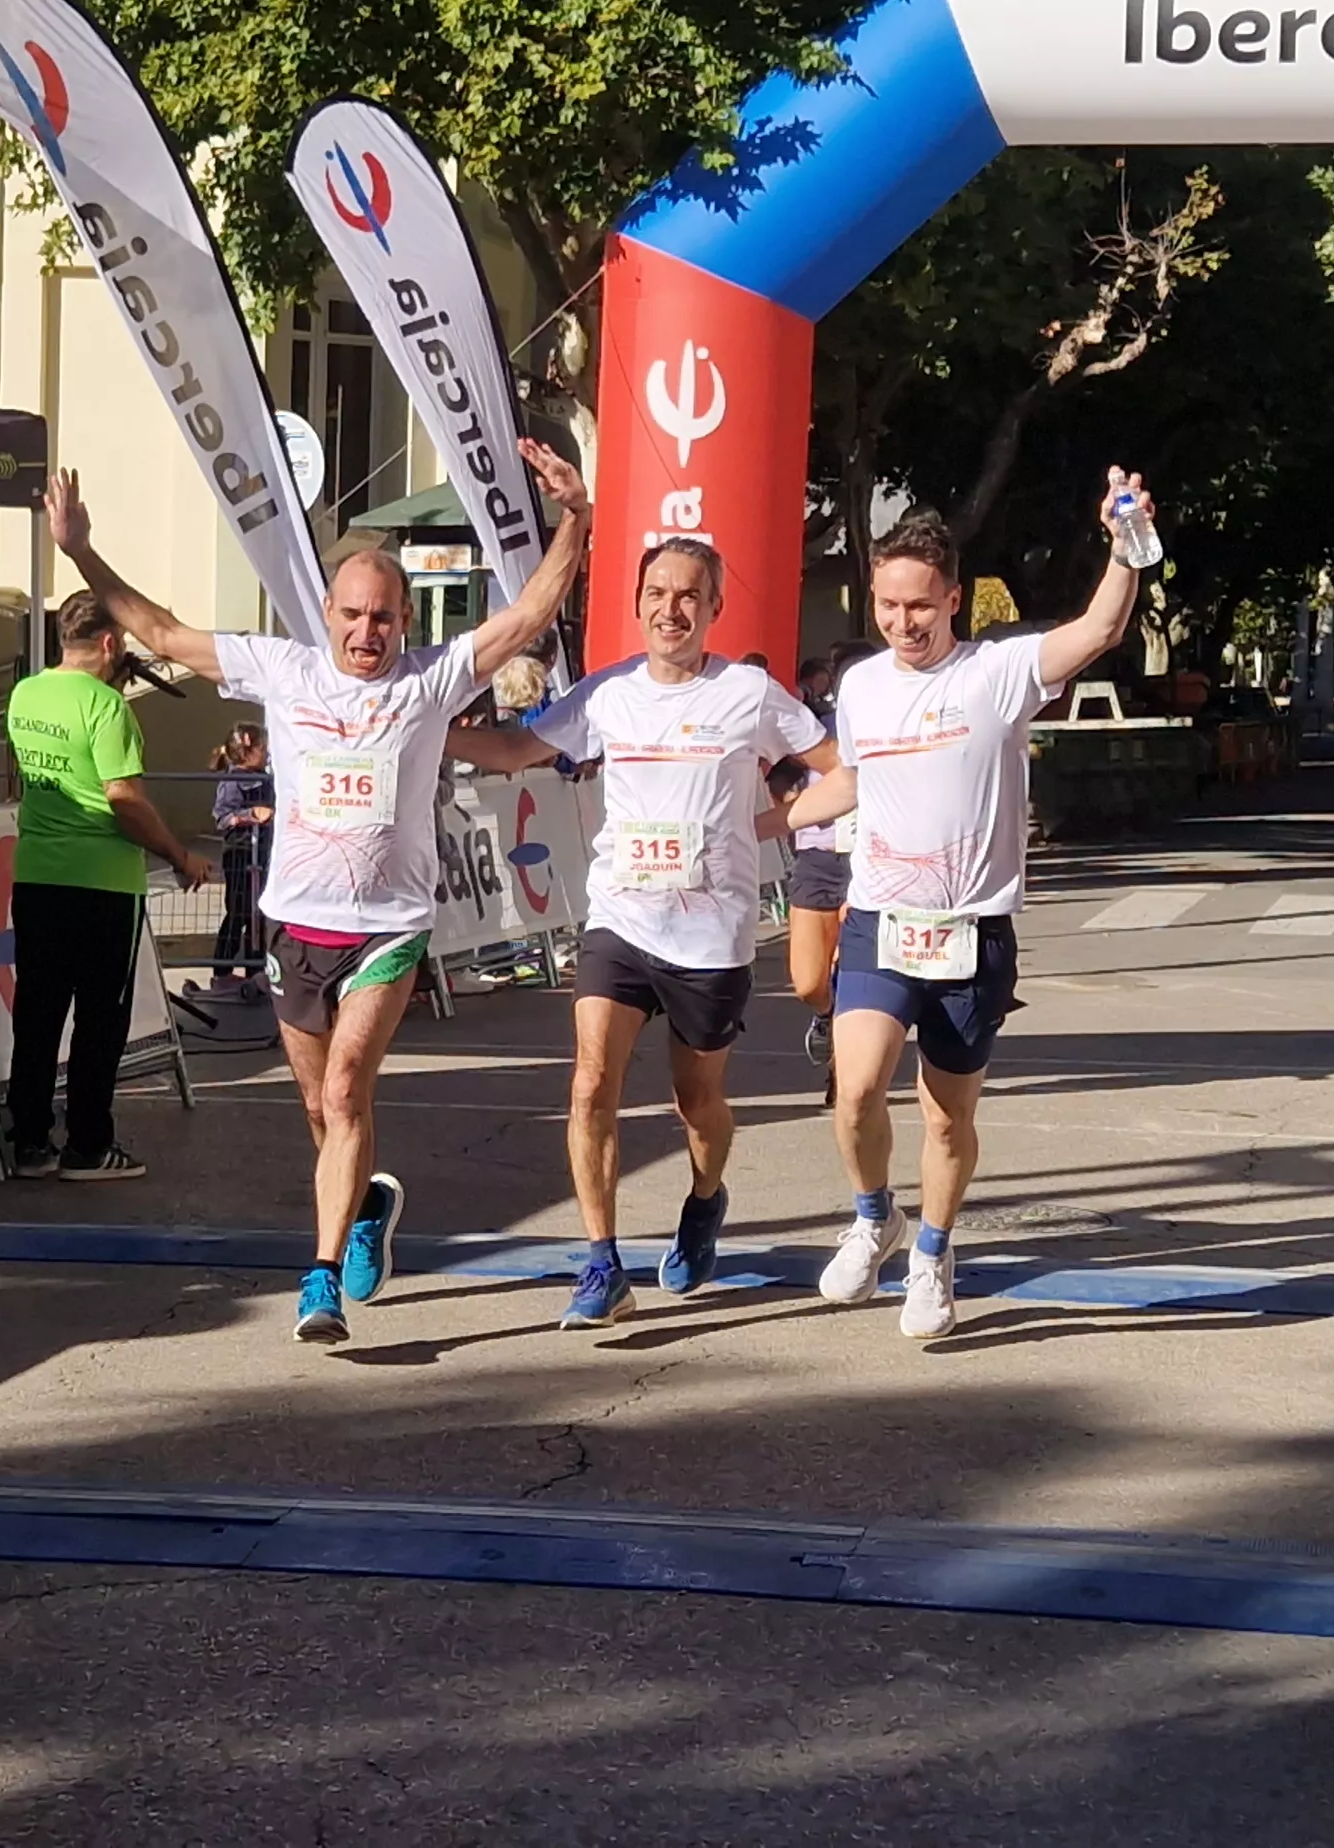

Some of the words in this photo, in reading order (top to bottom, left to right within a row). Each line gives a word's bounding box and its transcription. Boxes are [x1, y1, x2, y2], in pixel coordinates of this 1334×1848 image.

[320, 773, 373, 796] 316
[630, 839, 681, 861] 315
[902, 926, 954, 950] 317
